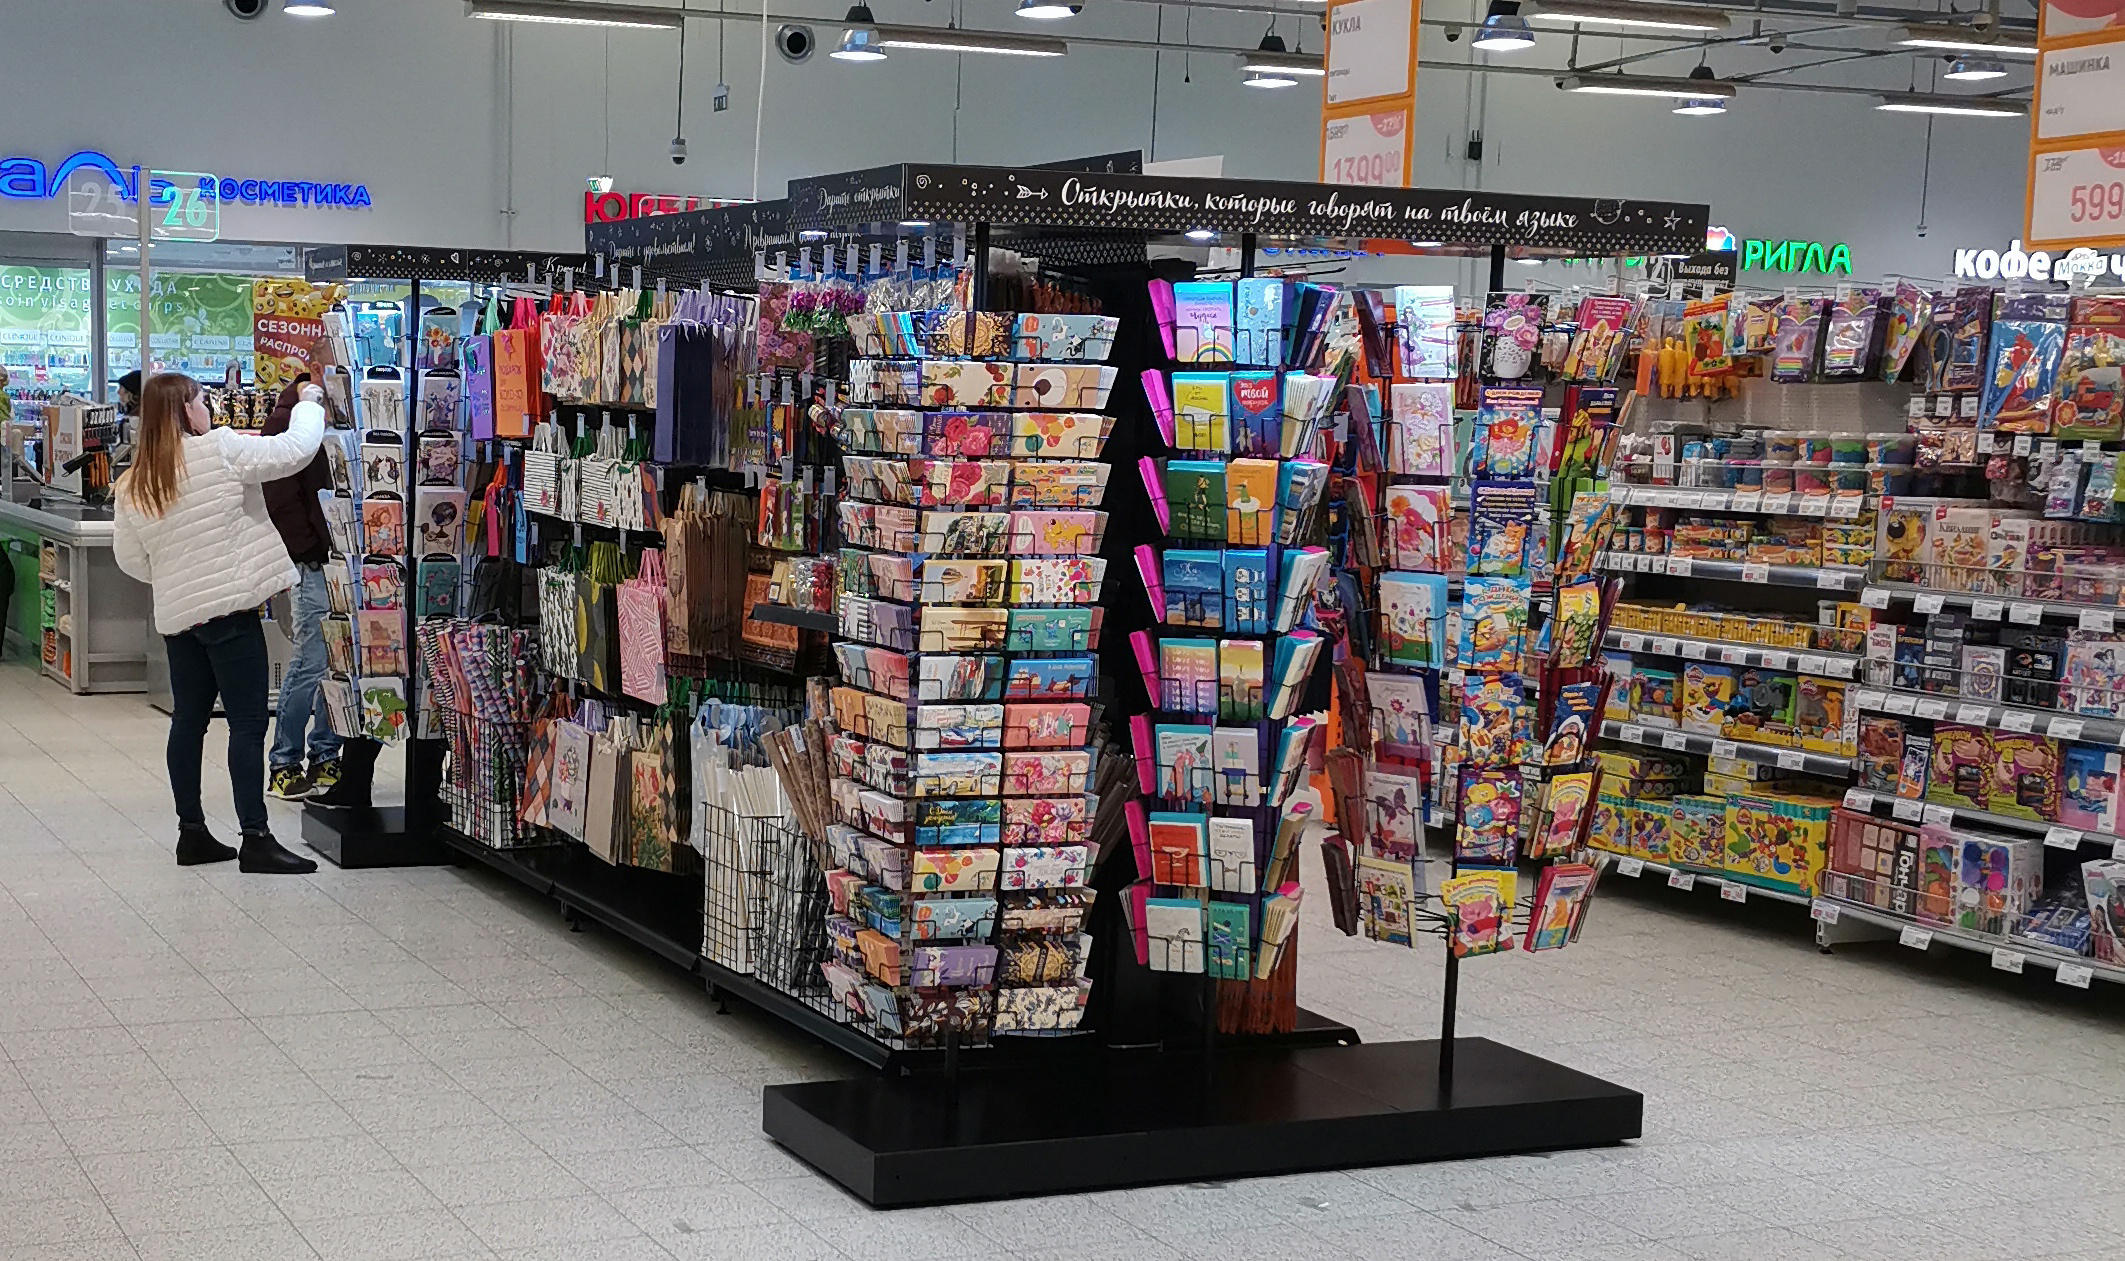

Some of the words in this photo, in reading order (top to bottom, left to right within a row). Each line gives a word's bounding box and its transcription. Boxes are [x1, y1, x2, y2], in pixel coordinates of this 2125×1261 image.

[1332, 16, 1361, 35] КУКЛА
[2049, 56, 2110, 76] МАШИНКА
[1333, 153, 1383, 185] 1399
[162, 187, 207, 227] 26
[199, 177, 371, 206] КОСМЕТИКА
[2071, 182, 2125, 222] 599
[1061, 177, 1199, 214] Открытки,
[1204, 193, 1297, 224] которые
[1307, 192, 1397, 229] говорят
[1404, 204, 1432, 220] на
[1440, 197, 1509, 229] твоём
[1516, 209, 1579, 239] языке
[1678, 261, 1712, 275] Выхода
[1714, 262, 1729, 275] без
[1741, 239, 1852, 274] РИГЛА
[1954, 239, 2051, 281] кофе
[112, 278, 178, 296] УХДА
